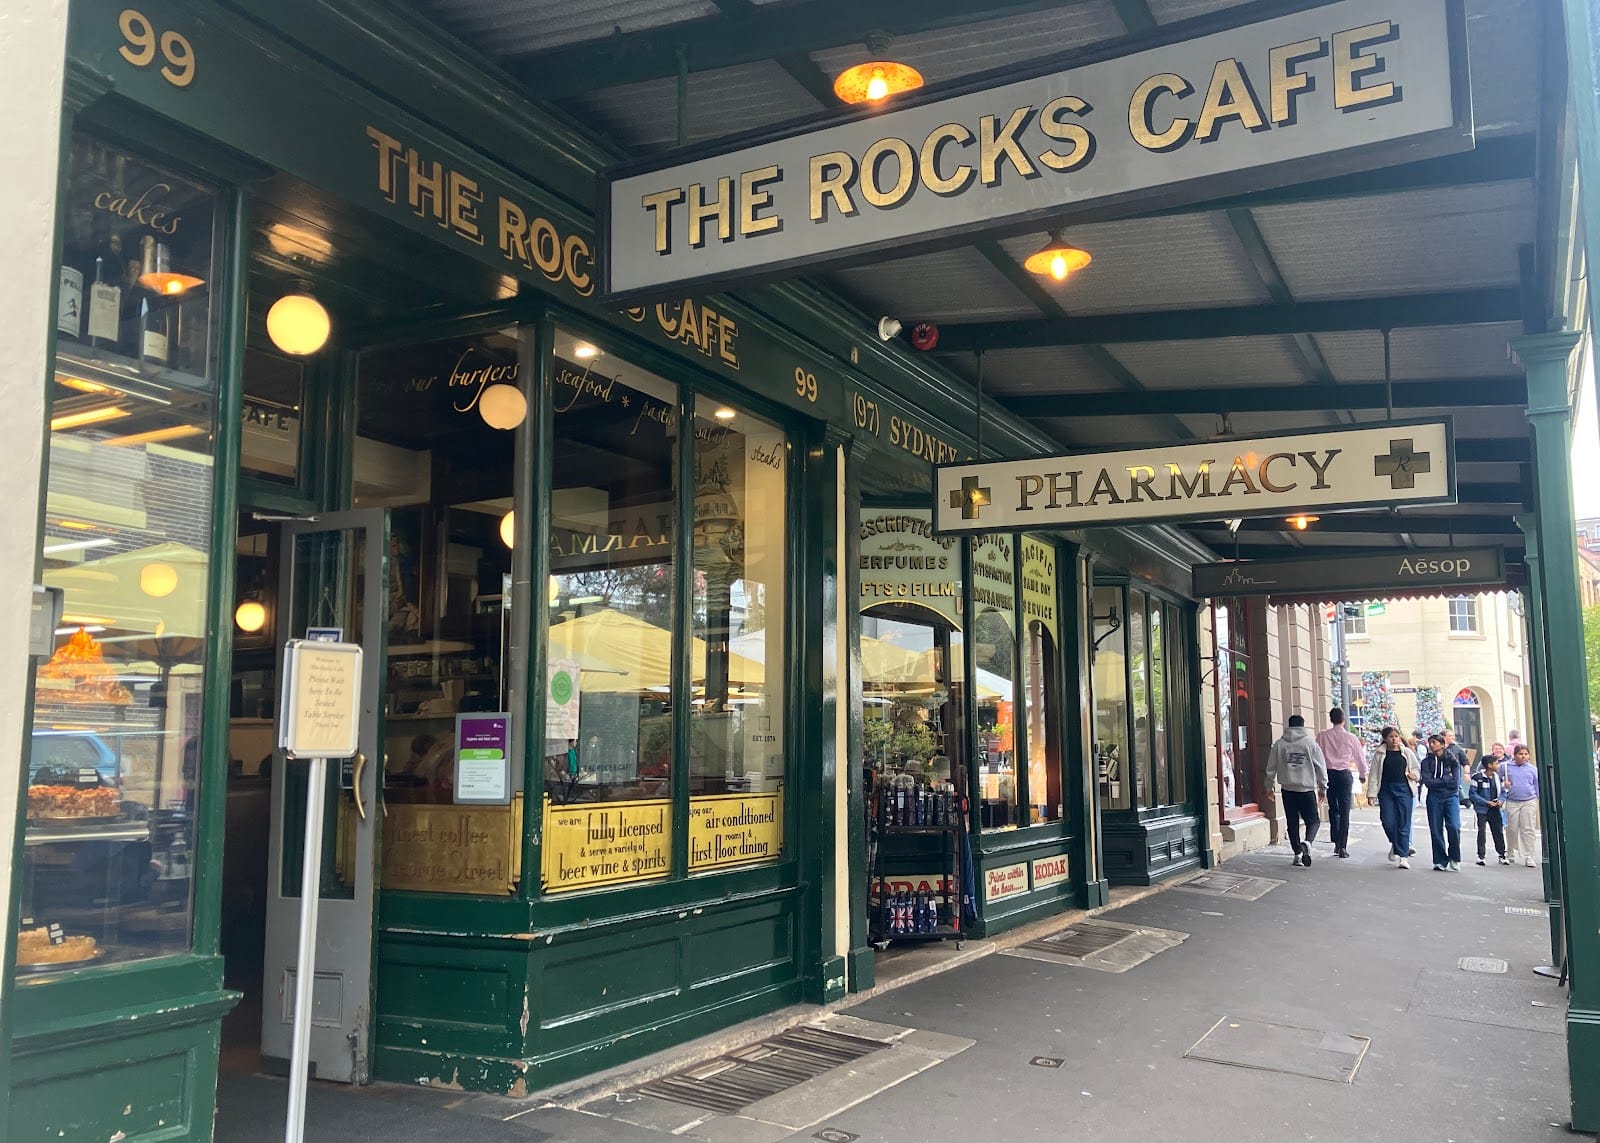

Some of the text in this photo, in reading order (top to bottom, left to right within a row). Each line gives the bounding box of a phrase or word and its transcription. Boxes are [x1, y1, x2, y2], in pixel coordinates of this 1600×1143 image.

[118, 9, 196, 87] 99
[641, 19, 1403, 256] THE ROCKS CAFE
[94, 183, 182, 236] cakes
[366, 125, 484, 246] THE
[655, 297, 740, 370] CAFE
[448, 347, 521, 412] burgers
[794, 367, 818, 403] 99
[554, 359, 623, 413] seafood
[751, 442, 781, 470] steaks
[852, 391, 958, 464] (97) SYDNEY
[1015, 448, 1342, 512] PHARMACY
[1398, 558, 1471, 578] Aēsop
[897, 582, 909, 597] &
[911, 581, 955, 597] FILM
[1040, 582, 1051, 597] DAY
[1023, 600, 1053, 620] SERVICE
[570, 818, 582, 826] are
[587, 811, 616, 845] fully
[618, 808, 664, 838] licensed
[705, 812, 721, 829] air
[722, 800, 775, 827] conditioned
[580, 847, 586, 858] &
[589, 848, 607, 857] serve
[614, 842, 637, 855] variety
[638, 835, 646, 853] of
[692, 831, 769, 866] first floor dining
[748, 829, 752, 838] &
[559, 848, 666, 881] beer wine & spirits
[988, 867, 1024, 885] Prints within
[1034, 859, 1066, 881] KODAK
[991, 885, 1000, 896] the
